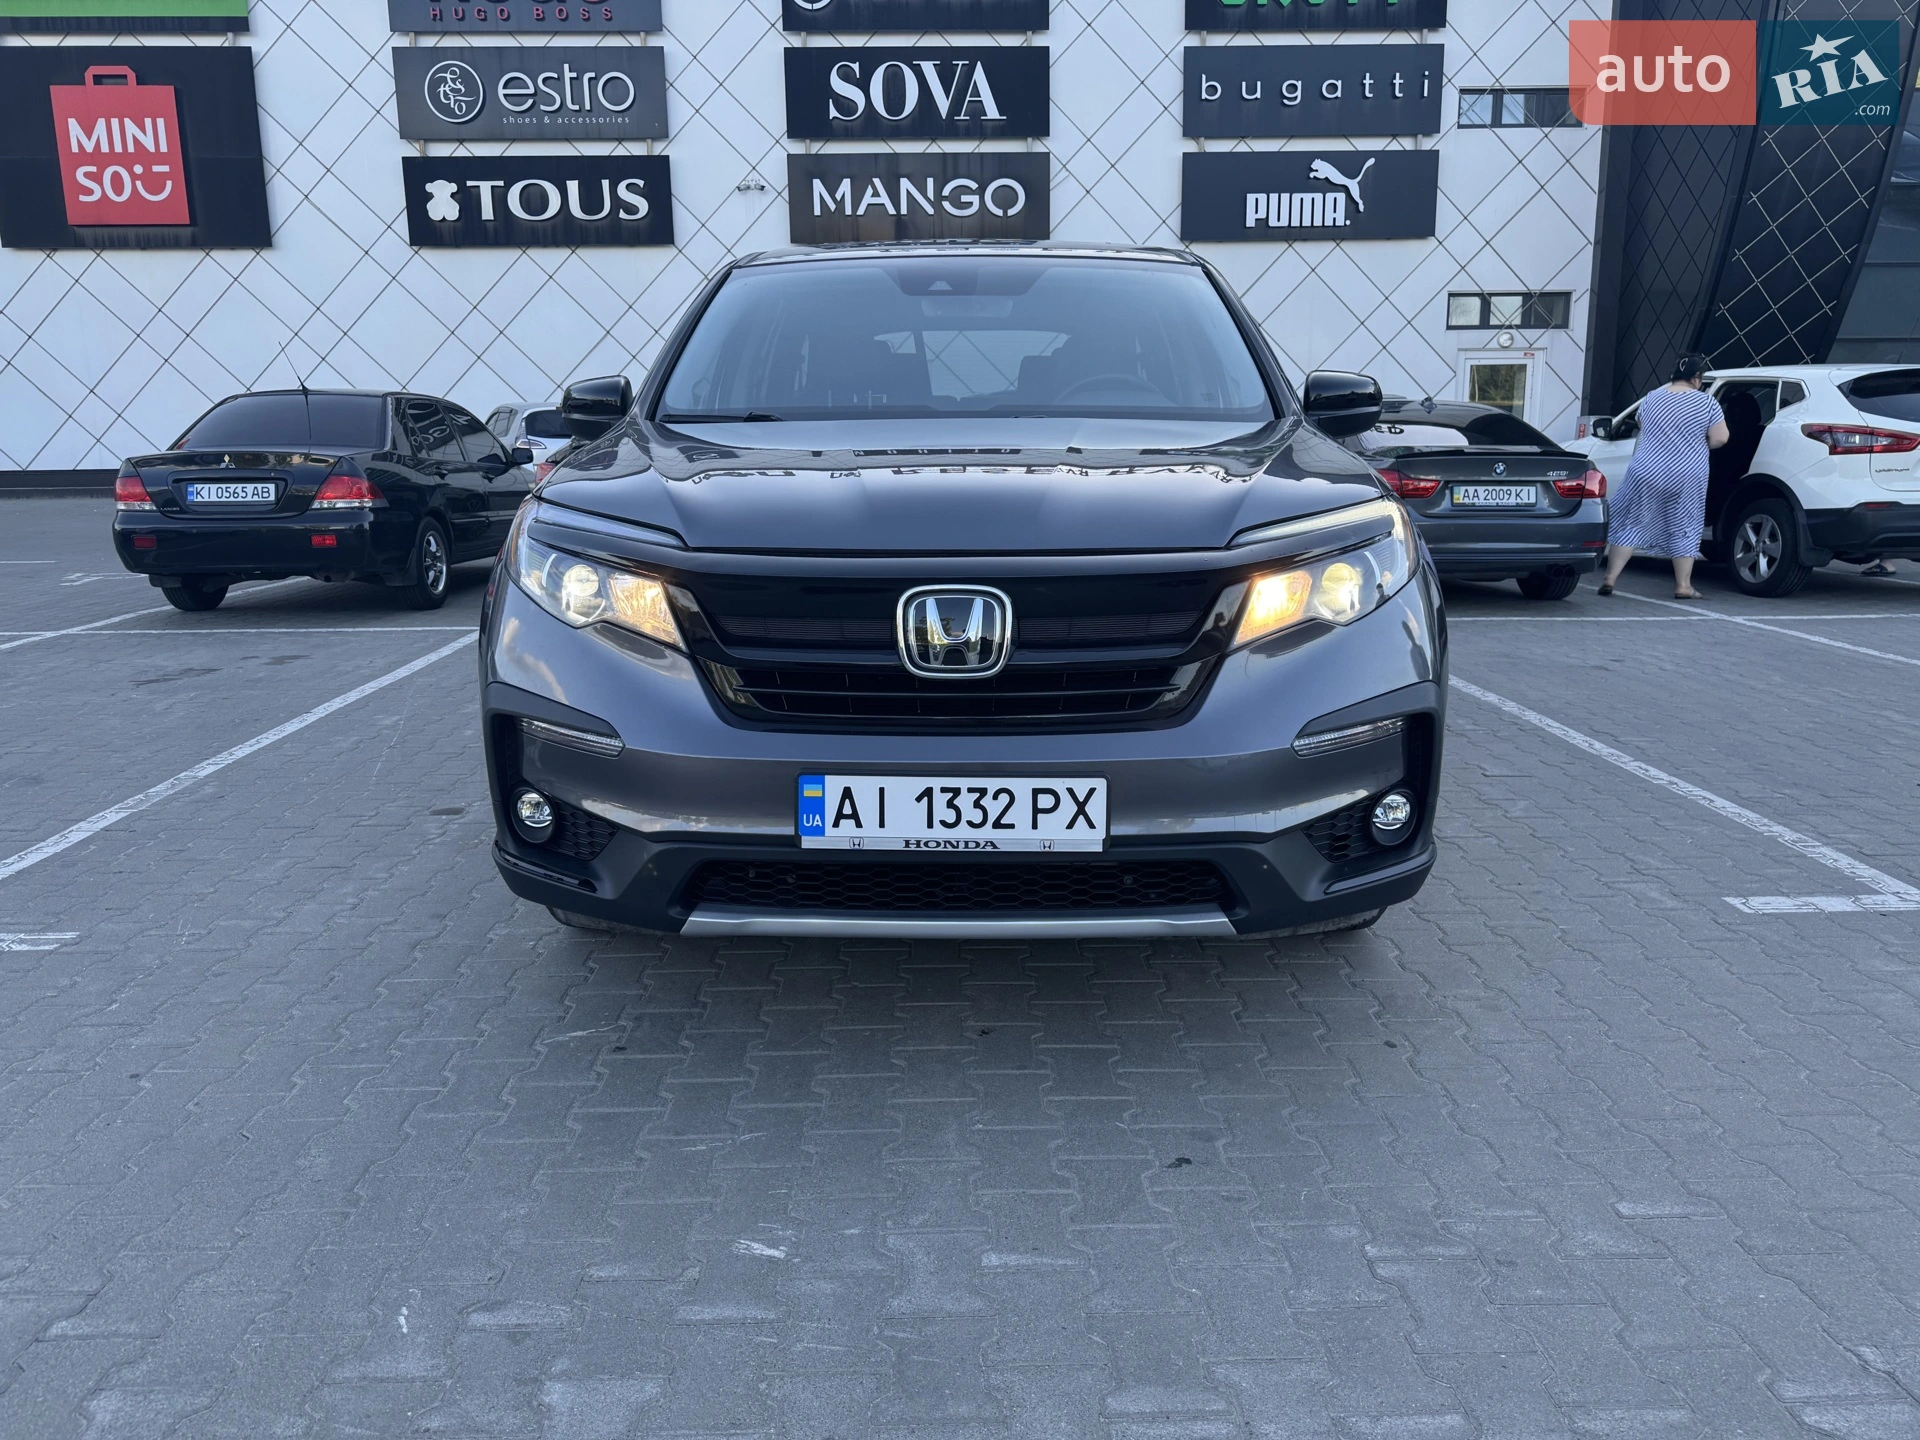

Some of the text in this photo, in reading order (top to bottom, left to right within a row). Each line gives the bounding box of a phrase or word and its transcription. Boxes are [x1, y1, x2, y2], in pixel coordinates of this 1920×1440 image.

[429, 6, 613, 20] HUGO BOSS
[497, 63, 635, 112] estro
[829, 60, 1007, 120] SOVA
[1201, 71, 1429, 106] bugatti
[67, 117, 168, 153] MINI
[502, 116, 630, 124] shoes & accessories
[466, 178, 649, 221] TOUS
[812, 177, 1026, 217] MANGO
[195, 486, 271, 500] KI 0565 AB
[1462, 488, 1531, 501] AA 2009 KI
[803, 813, 822, 827] UA
[831, 786, 1097, 830] AI 1332 PX
[902, 839, 1001, 851] HONDA
